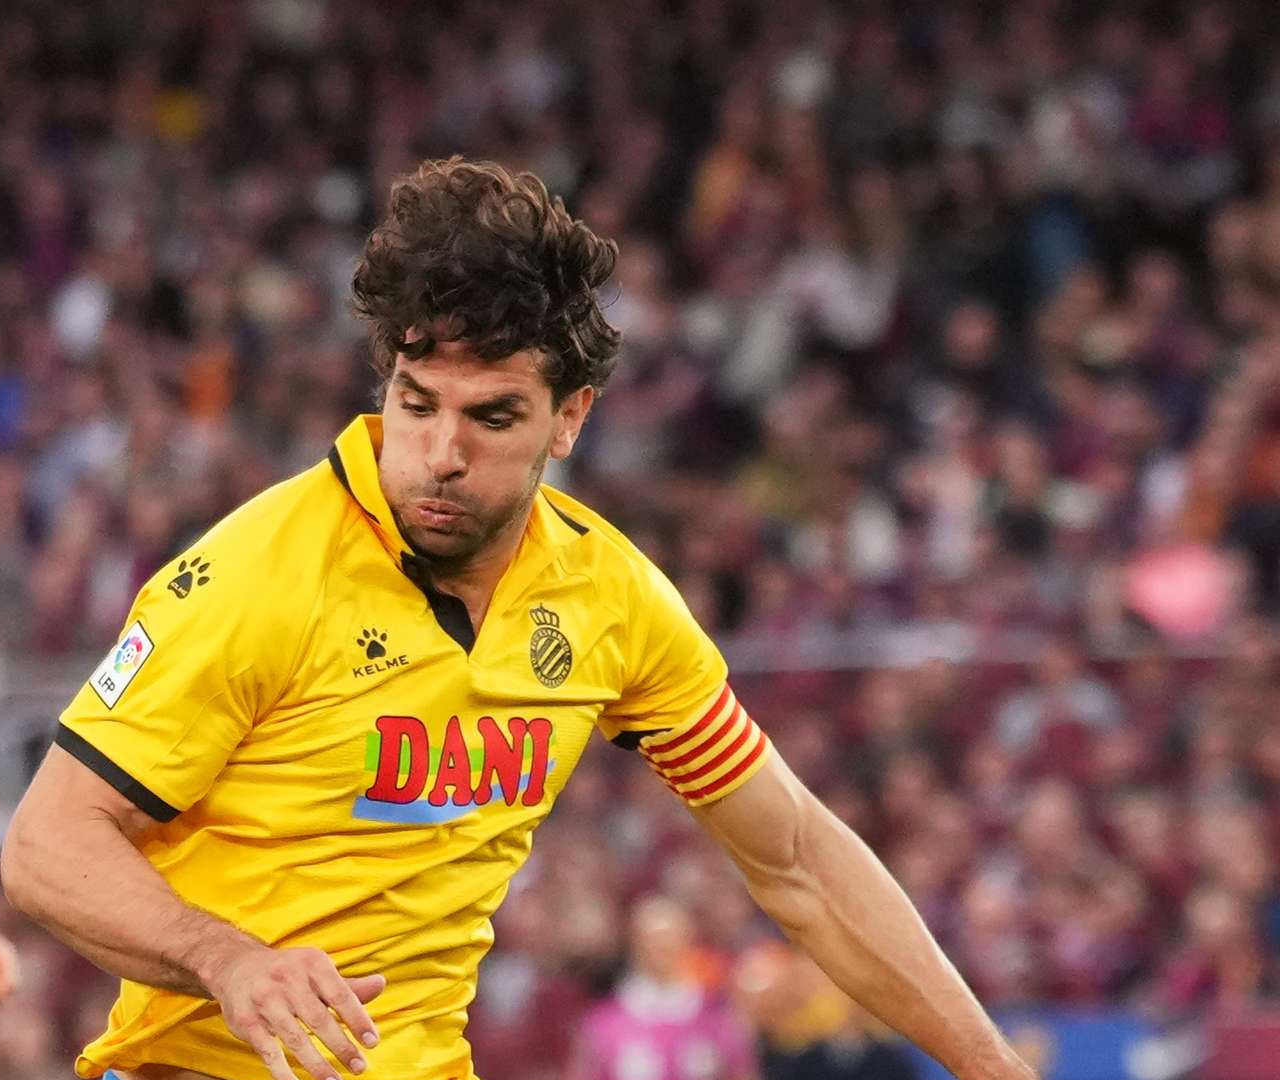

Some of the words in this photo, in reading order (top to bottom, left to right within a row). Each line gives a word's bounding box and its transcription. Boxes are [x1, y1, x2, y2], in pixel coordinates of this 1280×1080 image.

[352, 655, 409, 678] KELME
[98, 672, 116, 693] LFP
[365, 715, 553, 807] DANI
